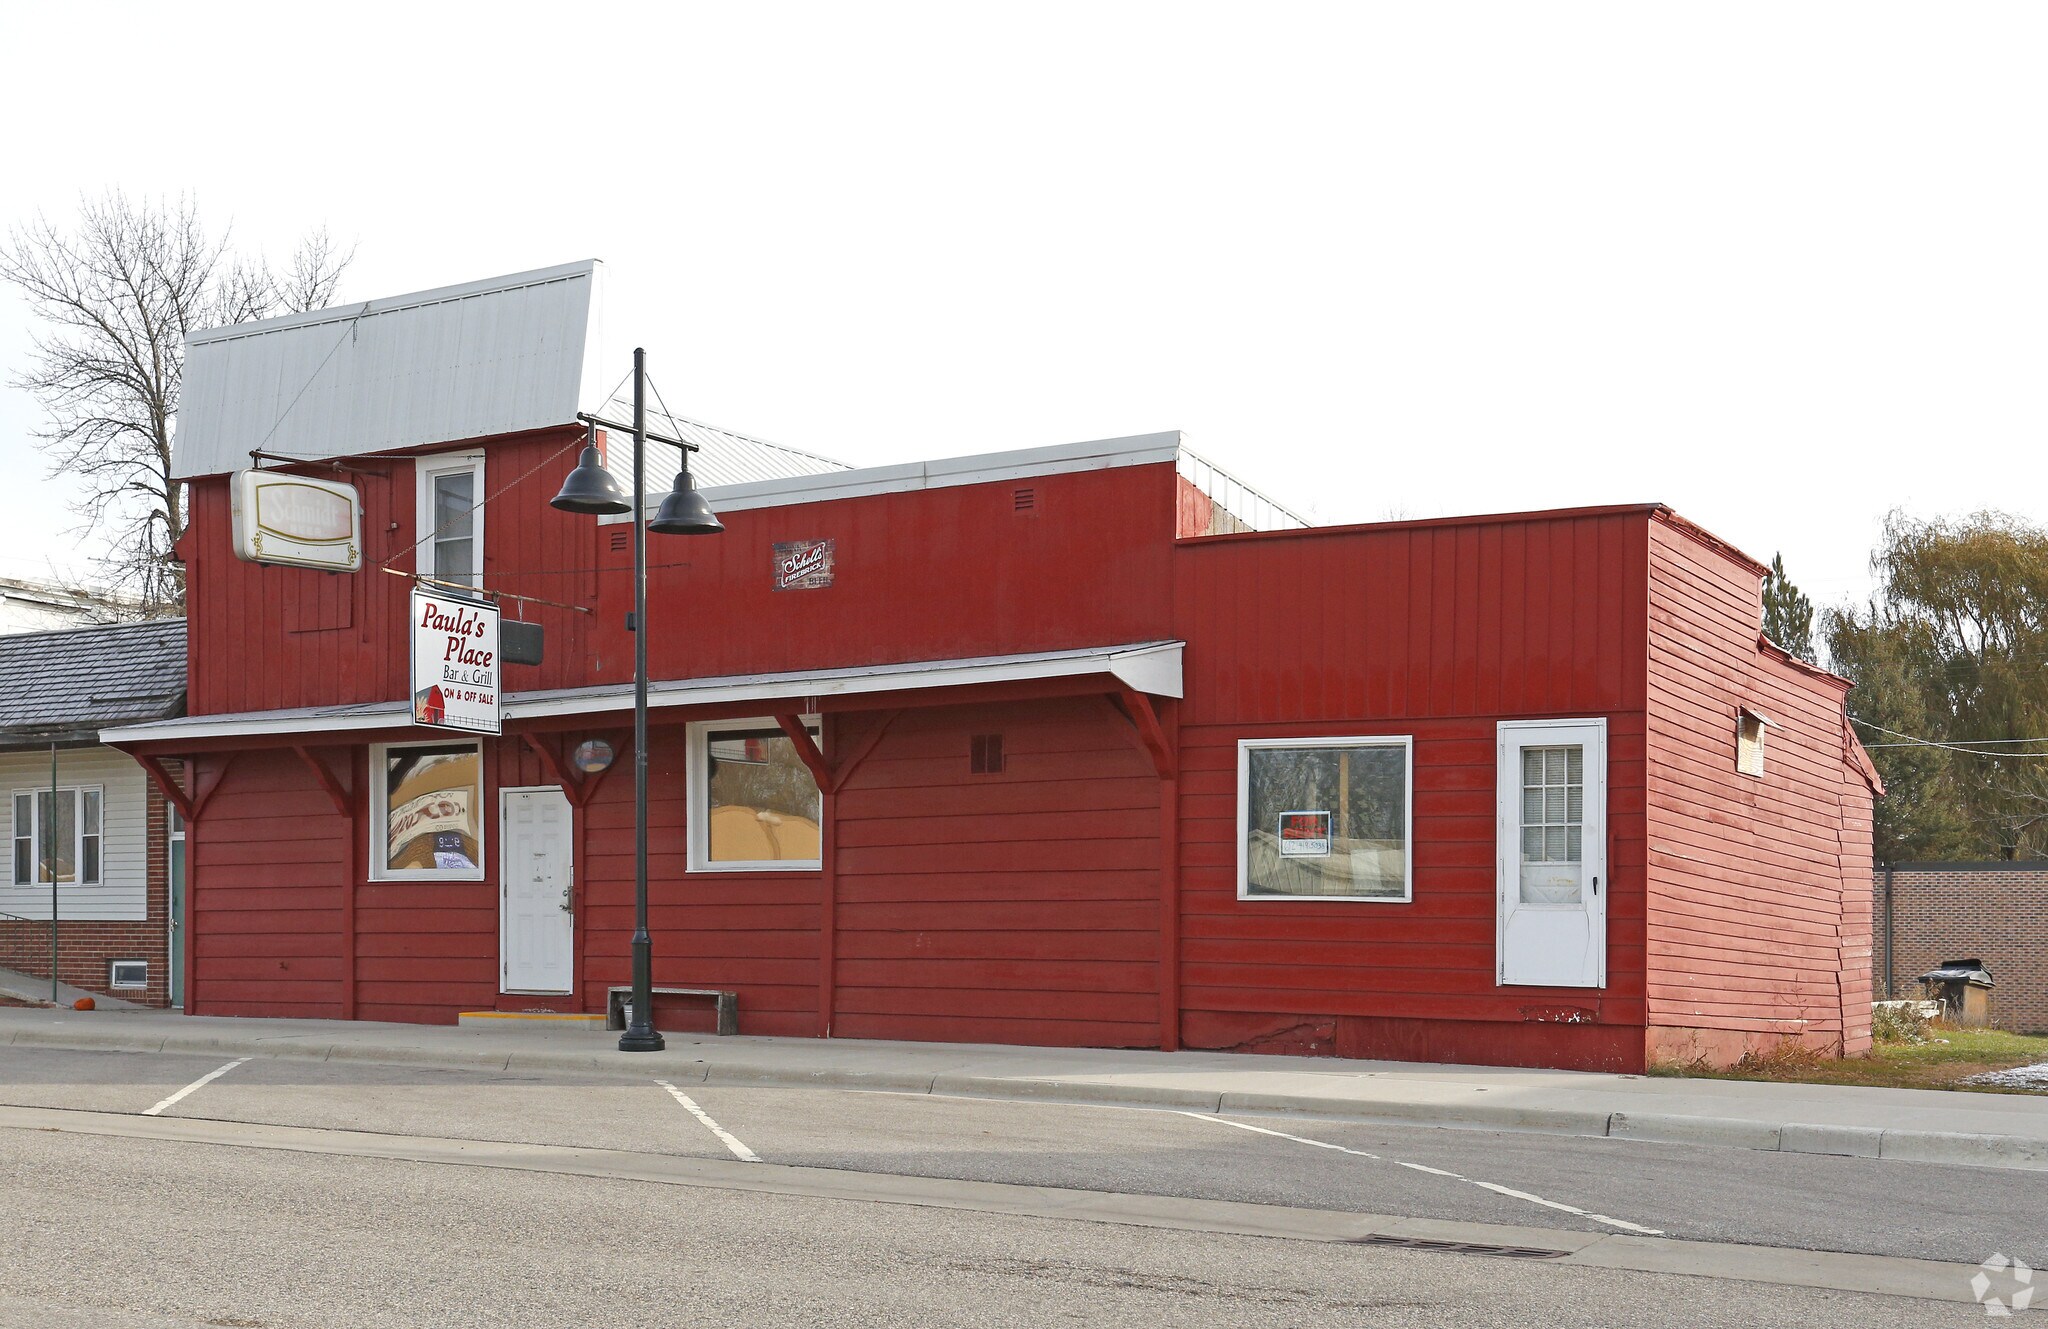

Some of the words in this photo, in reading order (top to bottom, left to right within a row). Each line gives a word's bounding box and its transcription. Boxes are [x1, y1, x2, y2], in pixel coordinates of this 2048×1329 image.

[785, 562, 821, 583] FIREBRICK
[421, 603, 485, 638] Paula's
[444, 636, 493, 667] Place
[443, 665, 459, 681] Bar
[461, 669, 469, 682] &
[472, 669, 492, 685] Grill
[444, 687, 455, 699] ON
[456, 689, 461, 700] &
[464, 690, 477, 703] OFF
[479, 693, 494, 705] SALE
[1291, 815, 1318, 827] FOR
[1284, 827, 1326, 839] RENT
